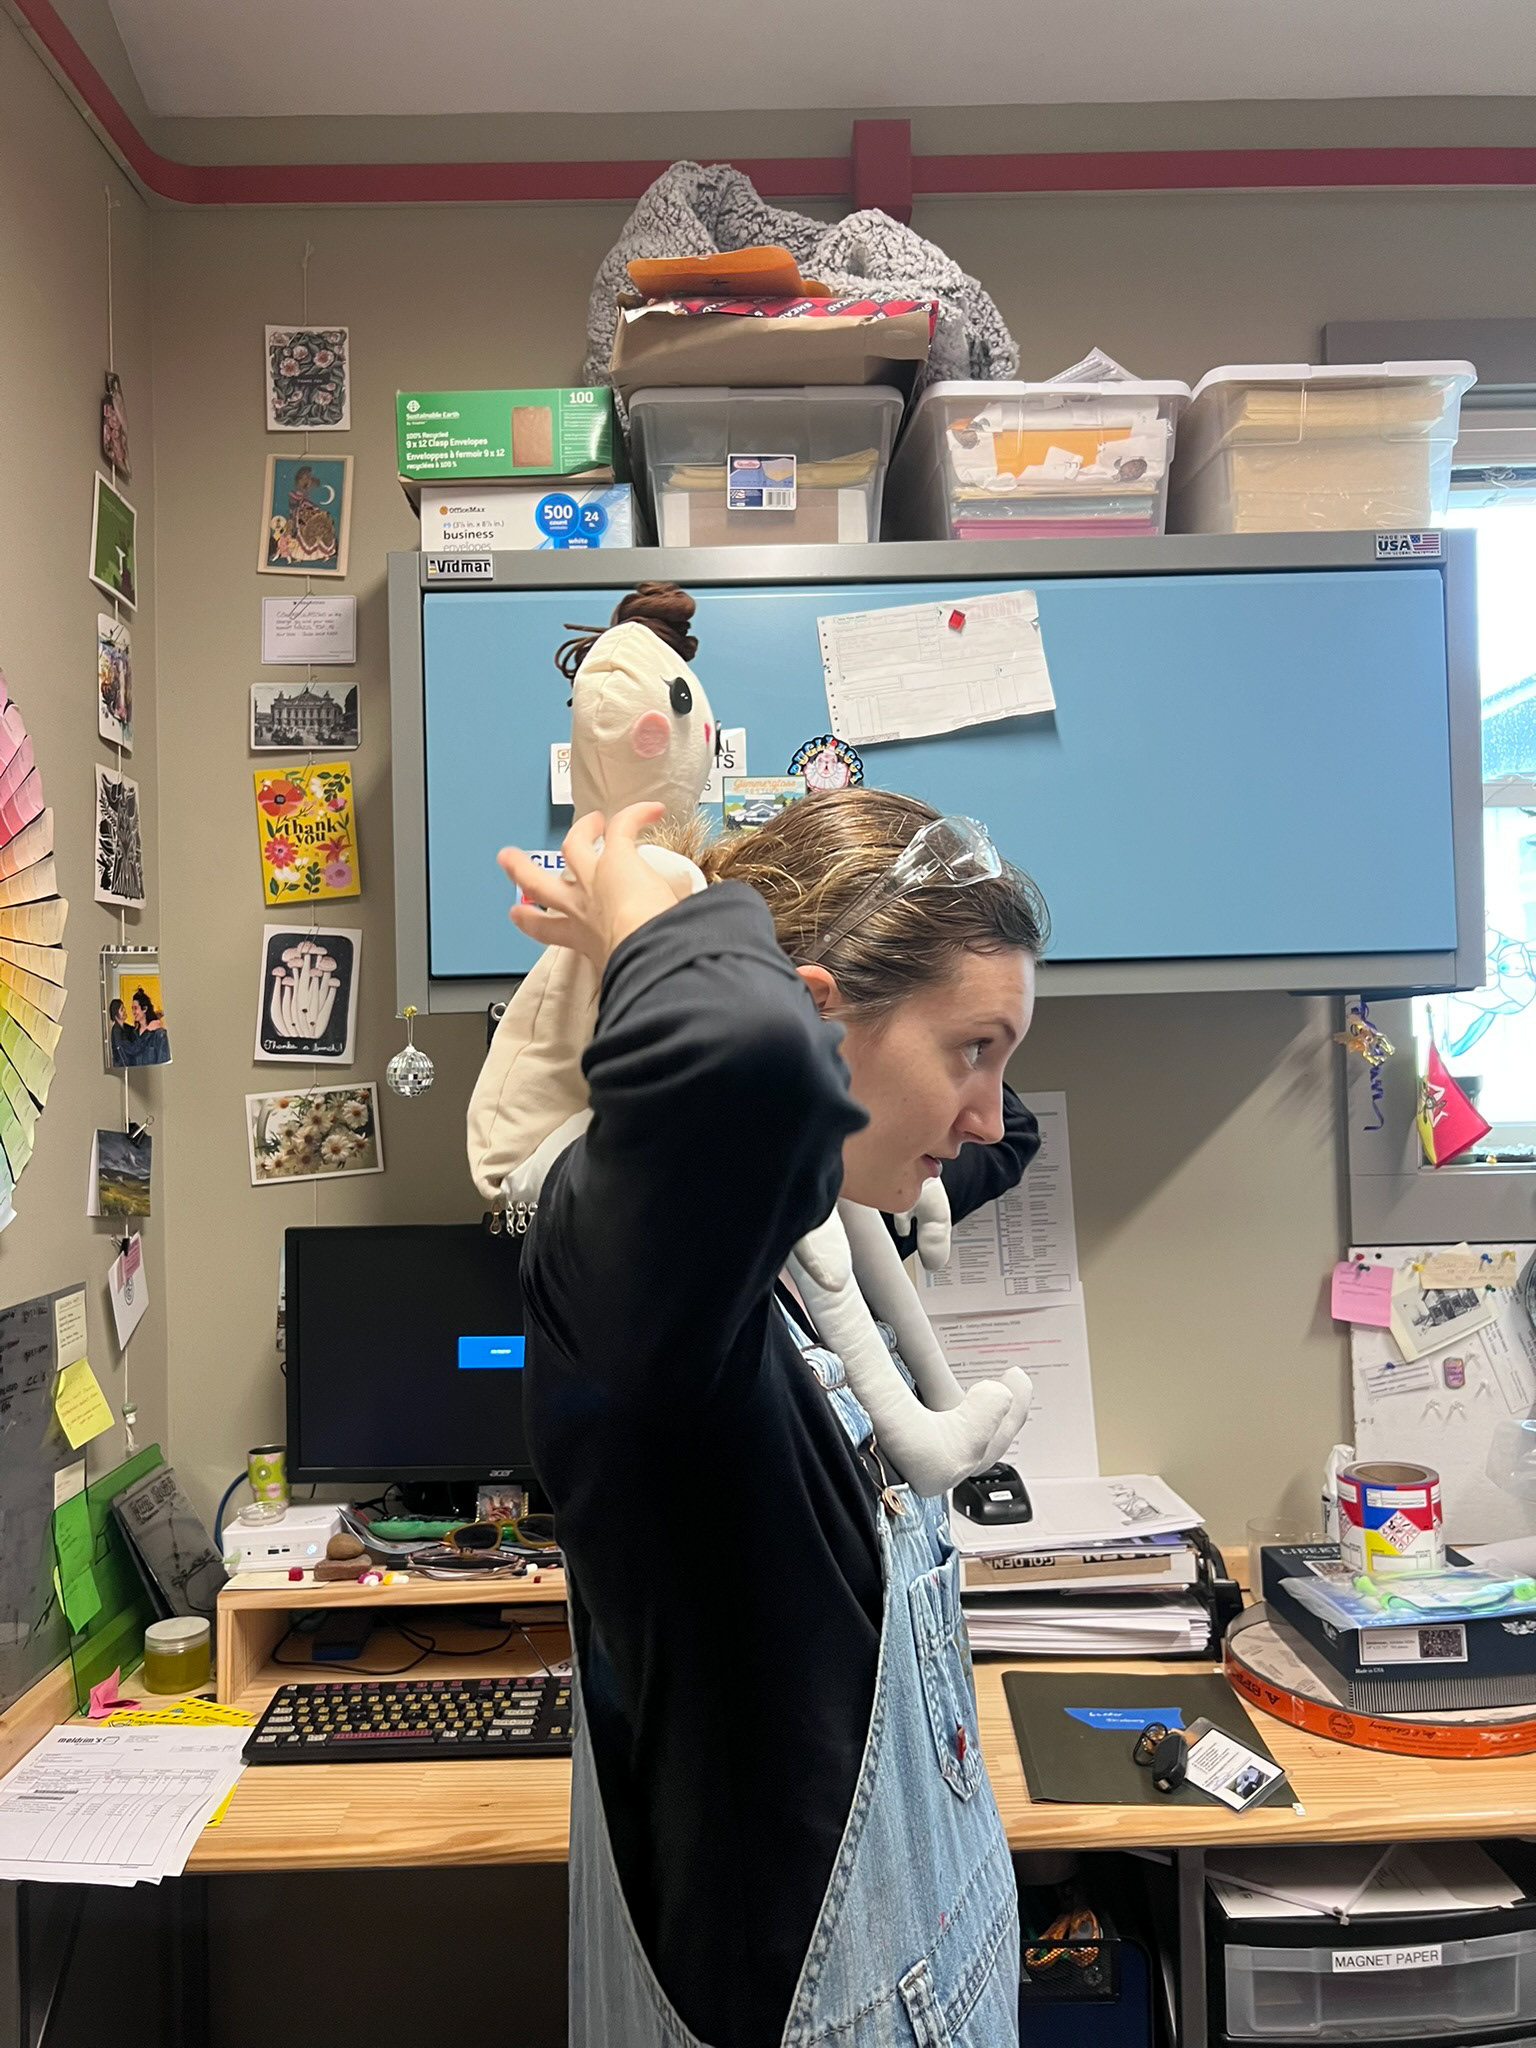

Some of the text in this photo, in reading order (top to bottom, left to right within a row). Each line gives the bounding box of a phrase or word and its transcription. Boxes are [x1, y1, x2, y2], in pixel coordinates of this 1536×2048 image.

[569, 391, 594, 404] 100
[406, 411, 460, 420] Sustainable Earth
[422, 431, 449, 441] Recycled
[406, 441, 411, 449] 9
[418, 440, 427, 448] 12
[428, 439, 449, 449] Clasp
[449, 438, 488, 447] Envelopes
[406, 450, 449, 462] Enveloppes
[449, 449, 455, 459] à
[455, 449, 482, 459] fermoir
[483, 449, 489, 458] 9
[496, 448, 505, 457] 12
[449, 506, 486, 514] OfficeMax
[544, 505, 573, 520] 500
[584, 511, 600, 522] 24
[443, 529, 495, 540] business
[443, 541, 493, 552] envelopes
[568, 537, 588, 545] white
[1378, 540, 1411, 551] USA
[437, 559, 491, 573] Vidmar
[284, 818, 338, 836] thank
[295, 832, 326, 848] you
[264, 1039, 298, 1050] Thanks
[312, 1042, 343, 1052] bunch!
[489, 1469, 514, 1477] acer
[1335, 1949, 1439, 1968] MAGNET PAPER
